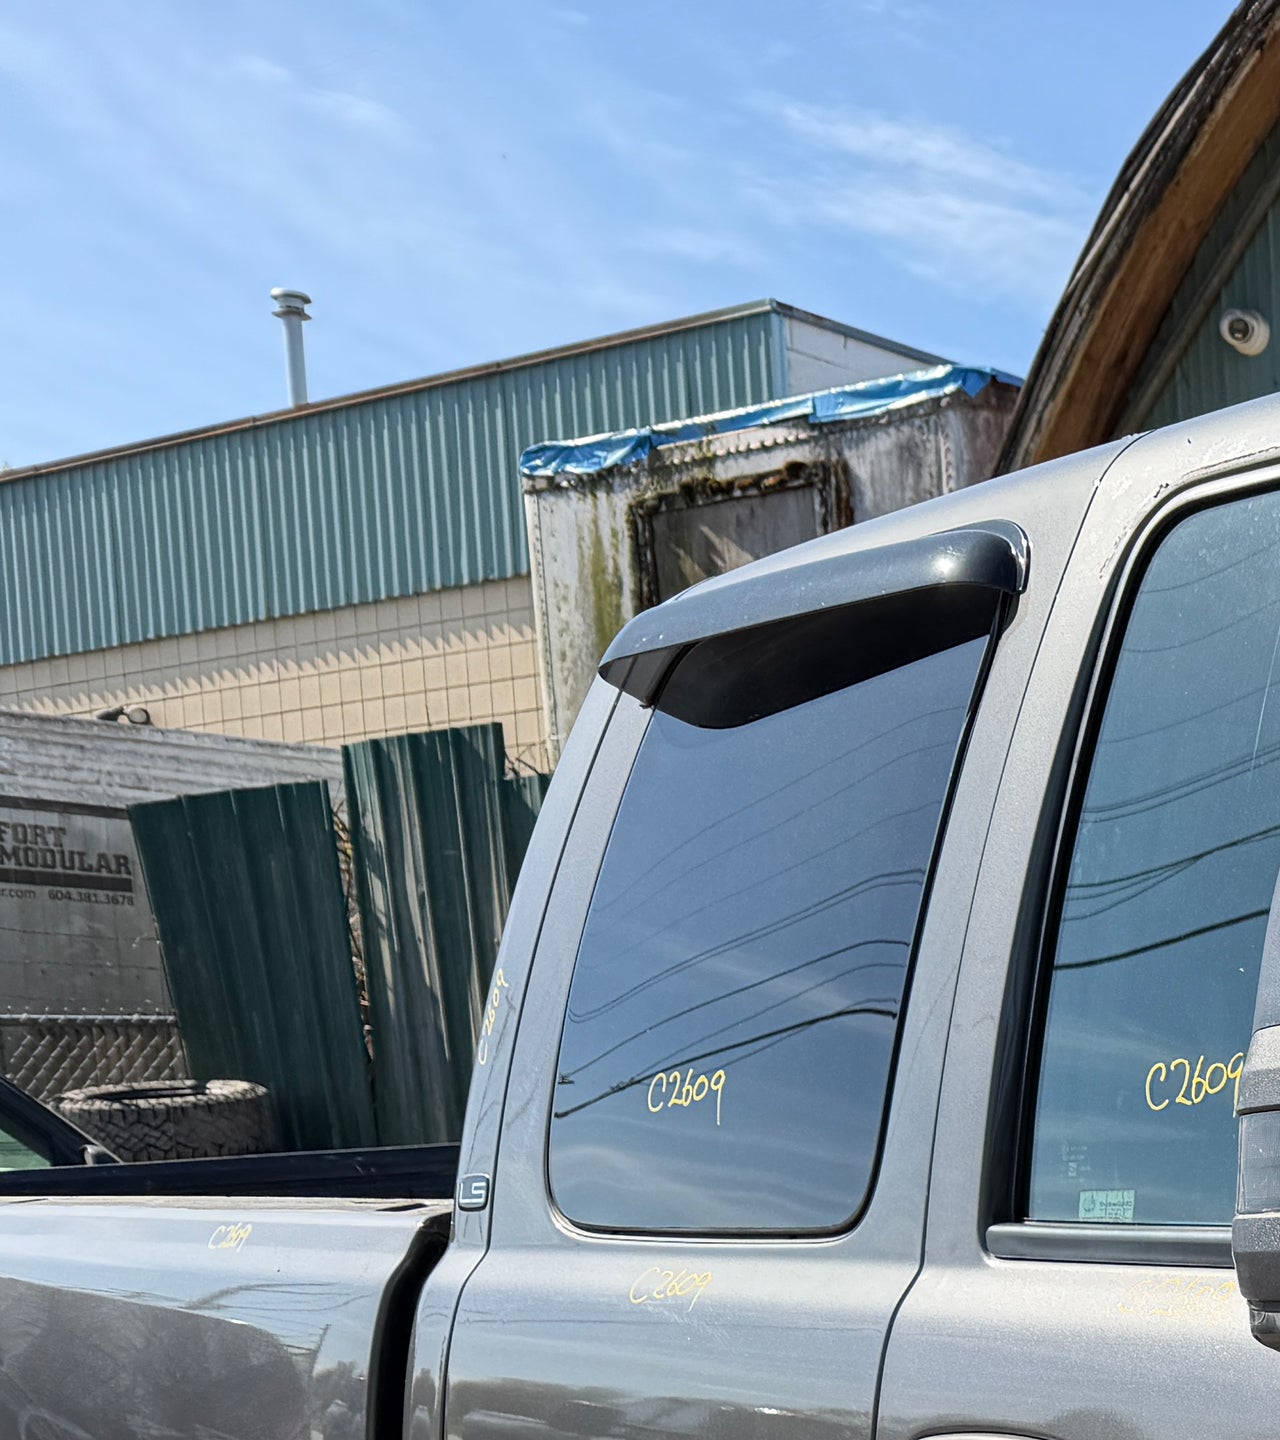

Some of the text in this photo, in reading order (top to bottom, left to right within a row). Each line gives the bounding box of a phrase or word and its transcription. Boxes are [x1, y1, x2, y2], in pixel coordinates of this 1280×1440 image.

[0, 821, 66, 848] FORT
[0, 843, 132, 876] MODULAR
[477, 968, 508, 1066] C2609
[647, 1068, 726, 1126] C2609
[1145, 1052, 1244, 1118] C2609
[459, 1181, 487, 1203] LS
[630, 1266, 713, 1312] C2609
